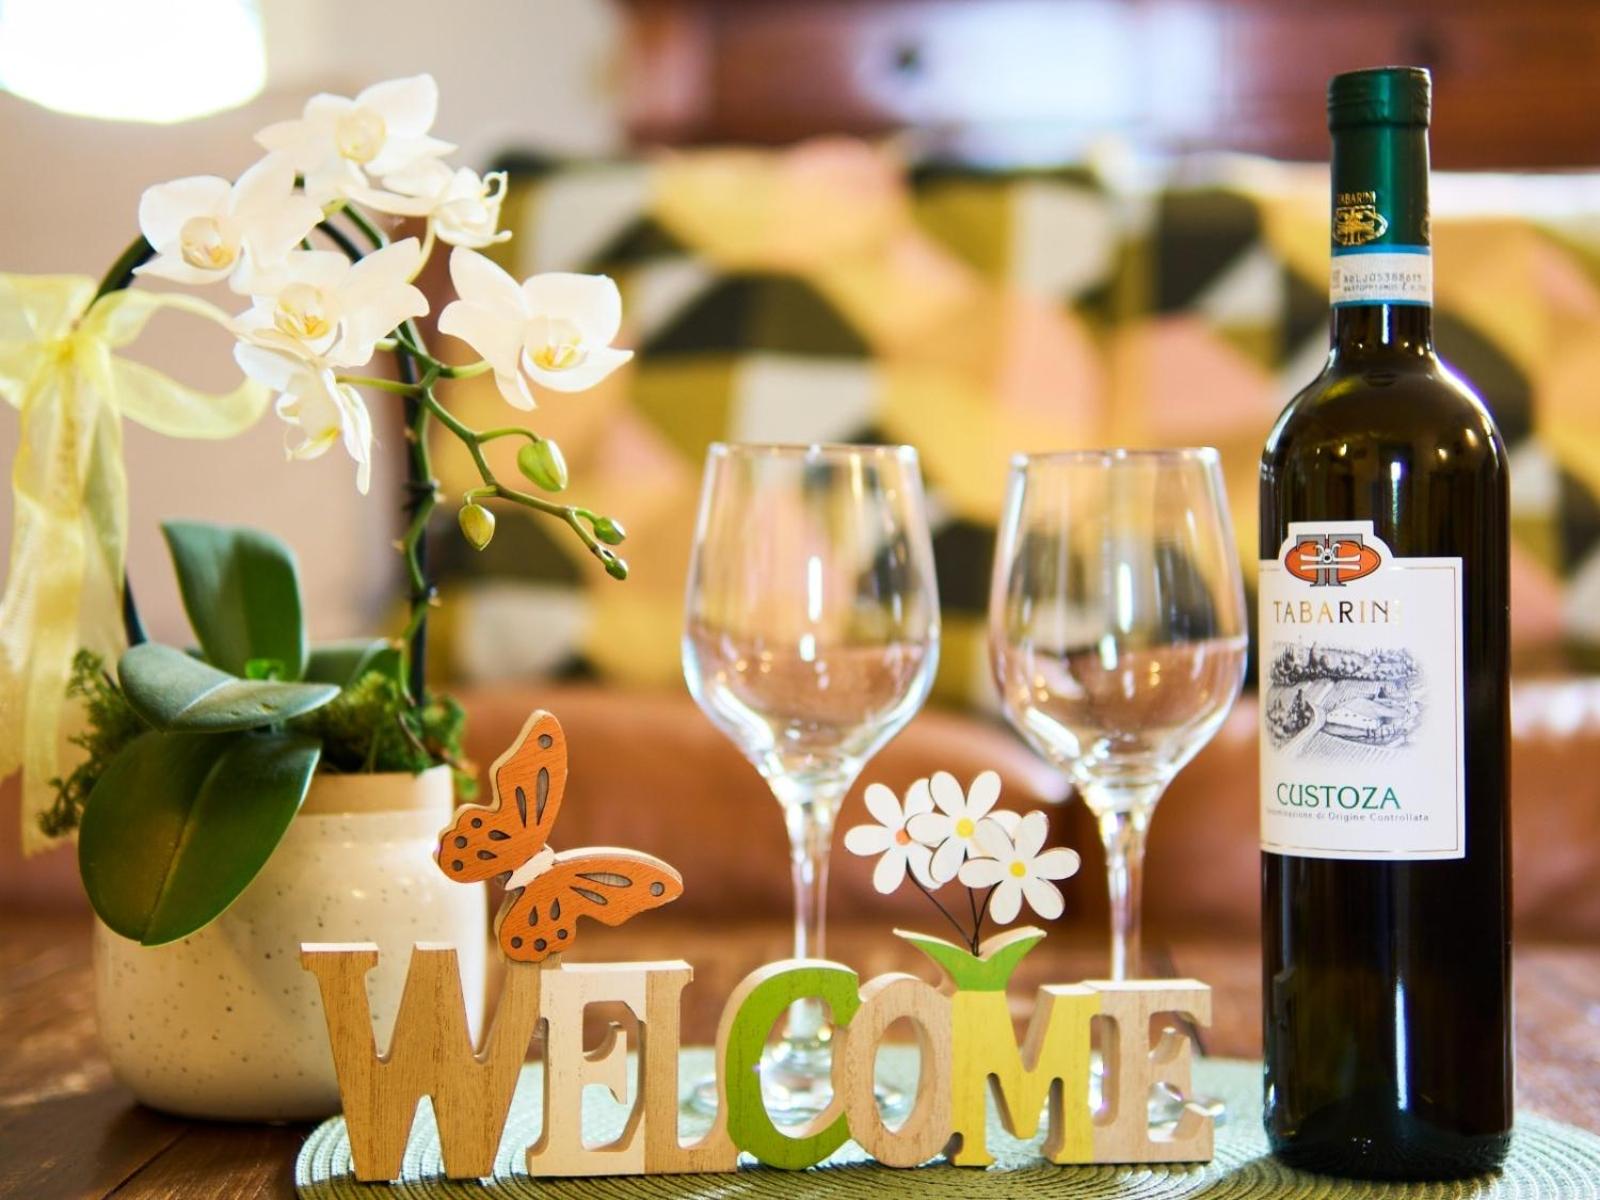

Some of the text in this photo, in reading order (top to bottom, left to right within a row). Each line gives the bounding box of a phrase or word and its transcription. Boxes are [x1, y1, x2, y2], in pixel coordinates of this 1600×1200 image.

[1276, 782, 1402, 810] CUSTOZA
[1328, 811, 1367, 823] Origine
[1369, 812, 1430, 823] Controllata
[300, 941, 1215, 1182] WELCOME
